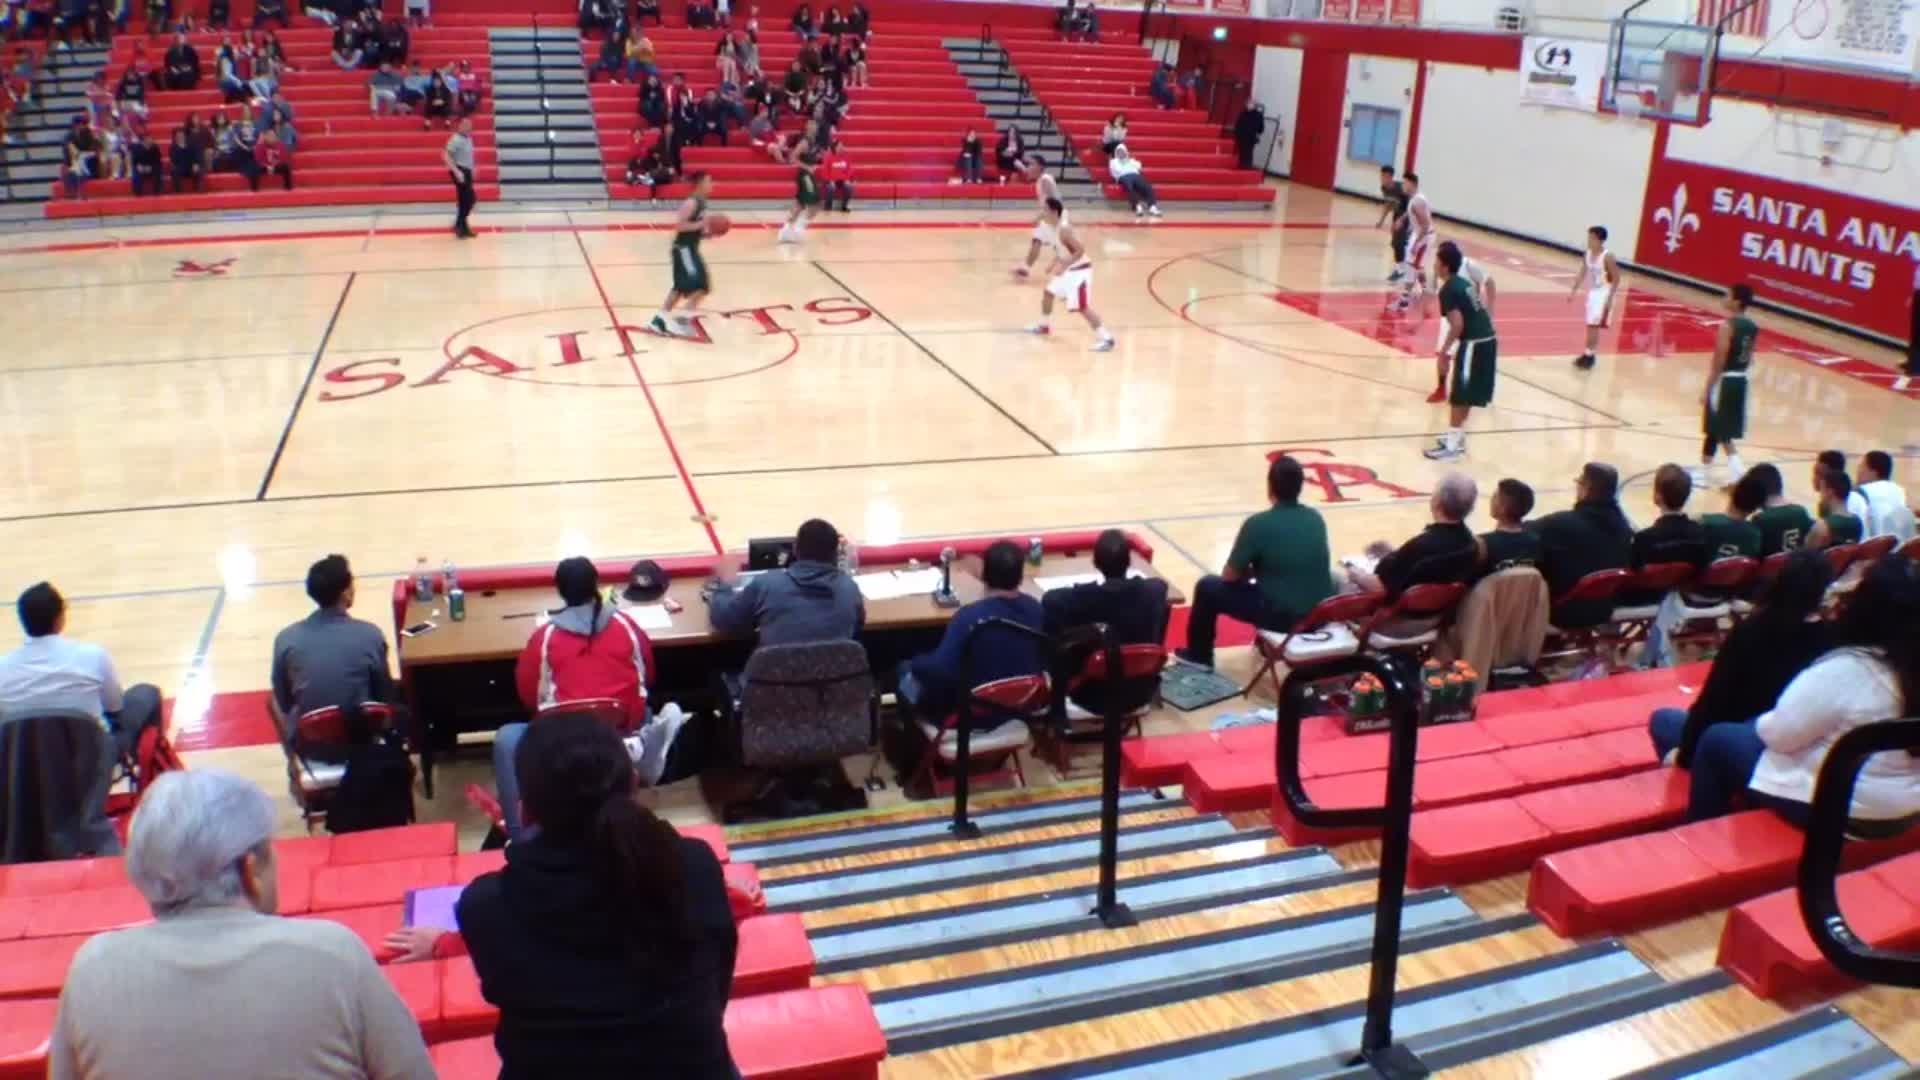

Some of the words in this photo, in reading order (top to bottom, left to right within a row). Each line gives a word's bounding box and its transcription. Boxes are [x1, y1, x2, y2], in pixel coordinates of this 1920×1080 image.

[1712, 186, 1828, 237] SANTA
[1837, 217, 1920, 263] ANA
[1740, 232, 1876, 290] SAINTS
[318, 296, 874, 402] SAINTS
